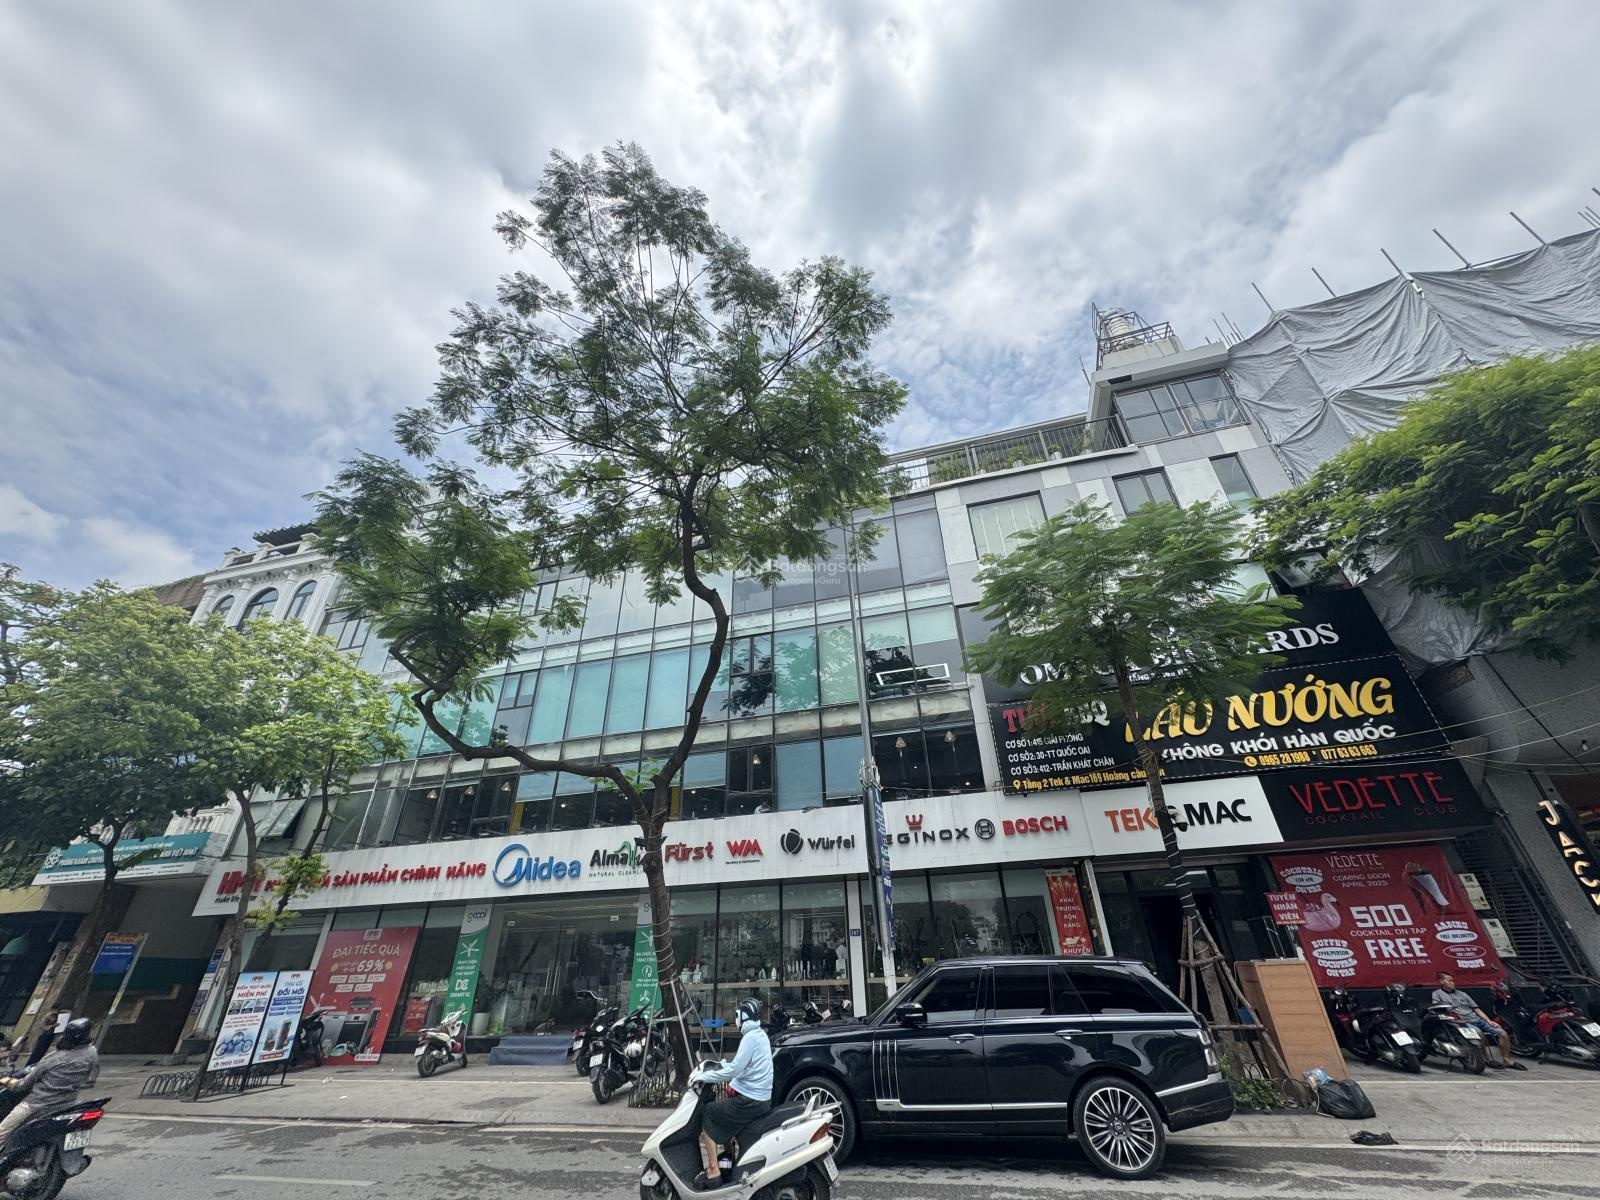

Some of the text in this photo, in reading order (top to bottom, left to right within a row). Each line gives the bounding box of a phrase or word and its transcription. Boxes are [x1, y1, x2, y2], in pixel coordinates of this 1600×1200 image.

[1225, 673, 1395, 735] NƯỚNG
[1230, 732, 1277, 755] KHÓI
[1285, 732, 1332, 749] HÀN
[1333, 718, 1397, 744] QUỐC
[1056, 745, 1078, 758] QUỐC
[1078, 746, 1091, 755] OAI
[1049, 777, 1064, 787] Tek
[1064, 776, 1071, 785] &
[1102, 770, 1130, 782] Hoàng
[1288, 771, 1454, 815] VEDETTE
[1304, 803, 1458, 825] COCKTAIL CLUB
[1002, 815, 1068, 836] BOSCH
[664, 841, 714, 863] Fürst
[726, 838, 763, 858] WM
[807, 834, 855, 851] Würfel
[496, 849, 581, 884] Midea
[1324, 853, 1383, 868] VEDETTE
[332, 869, 361, 888] SẢN
[360, 863, 399, 885] PHẨM
[400, 864, 442, 882] CHÍNH
[445, 861, 487, 879] HÃNG
[1367, 872, 1391, 880] SOON
[1273, 903, 1298, 911] NHÂN
[1278, 912, 1300, 920] VIÊN
[1349, 904, 1413, 928] 500
[1350, 927, 1428, 937] COCKTAIL ON TAP
[331, 946, 353, 959] ĐẠI
[354, 941, 378, 956] TIỆC
[1364, 937, 1429, 959] FREE
[356, 959, 386, 972] 69%
